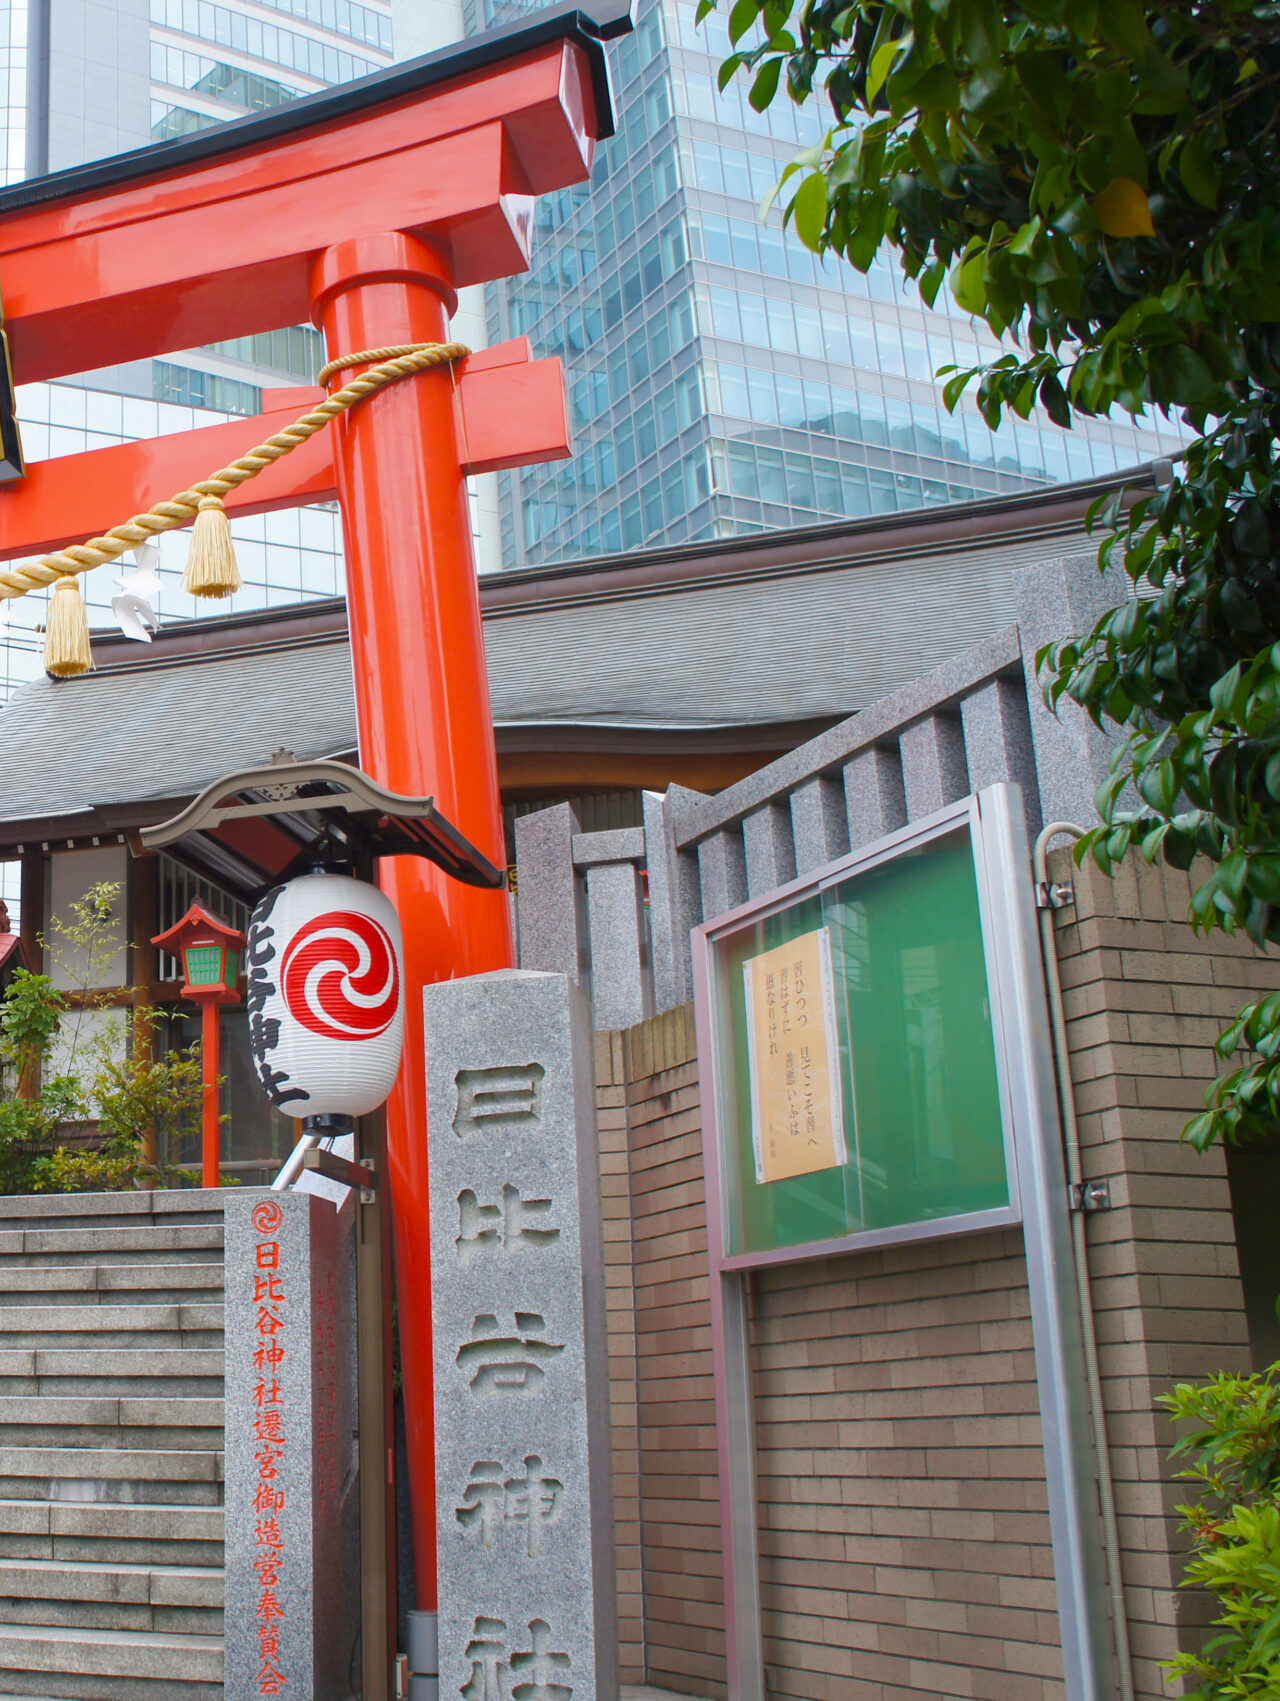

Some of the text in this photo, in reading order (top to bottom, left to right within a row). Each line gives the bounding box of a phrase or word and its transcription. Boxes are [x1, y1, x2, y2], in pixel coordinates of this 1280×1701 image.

[451, 1062, 573, 1701] 日比谷神社
